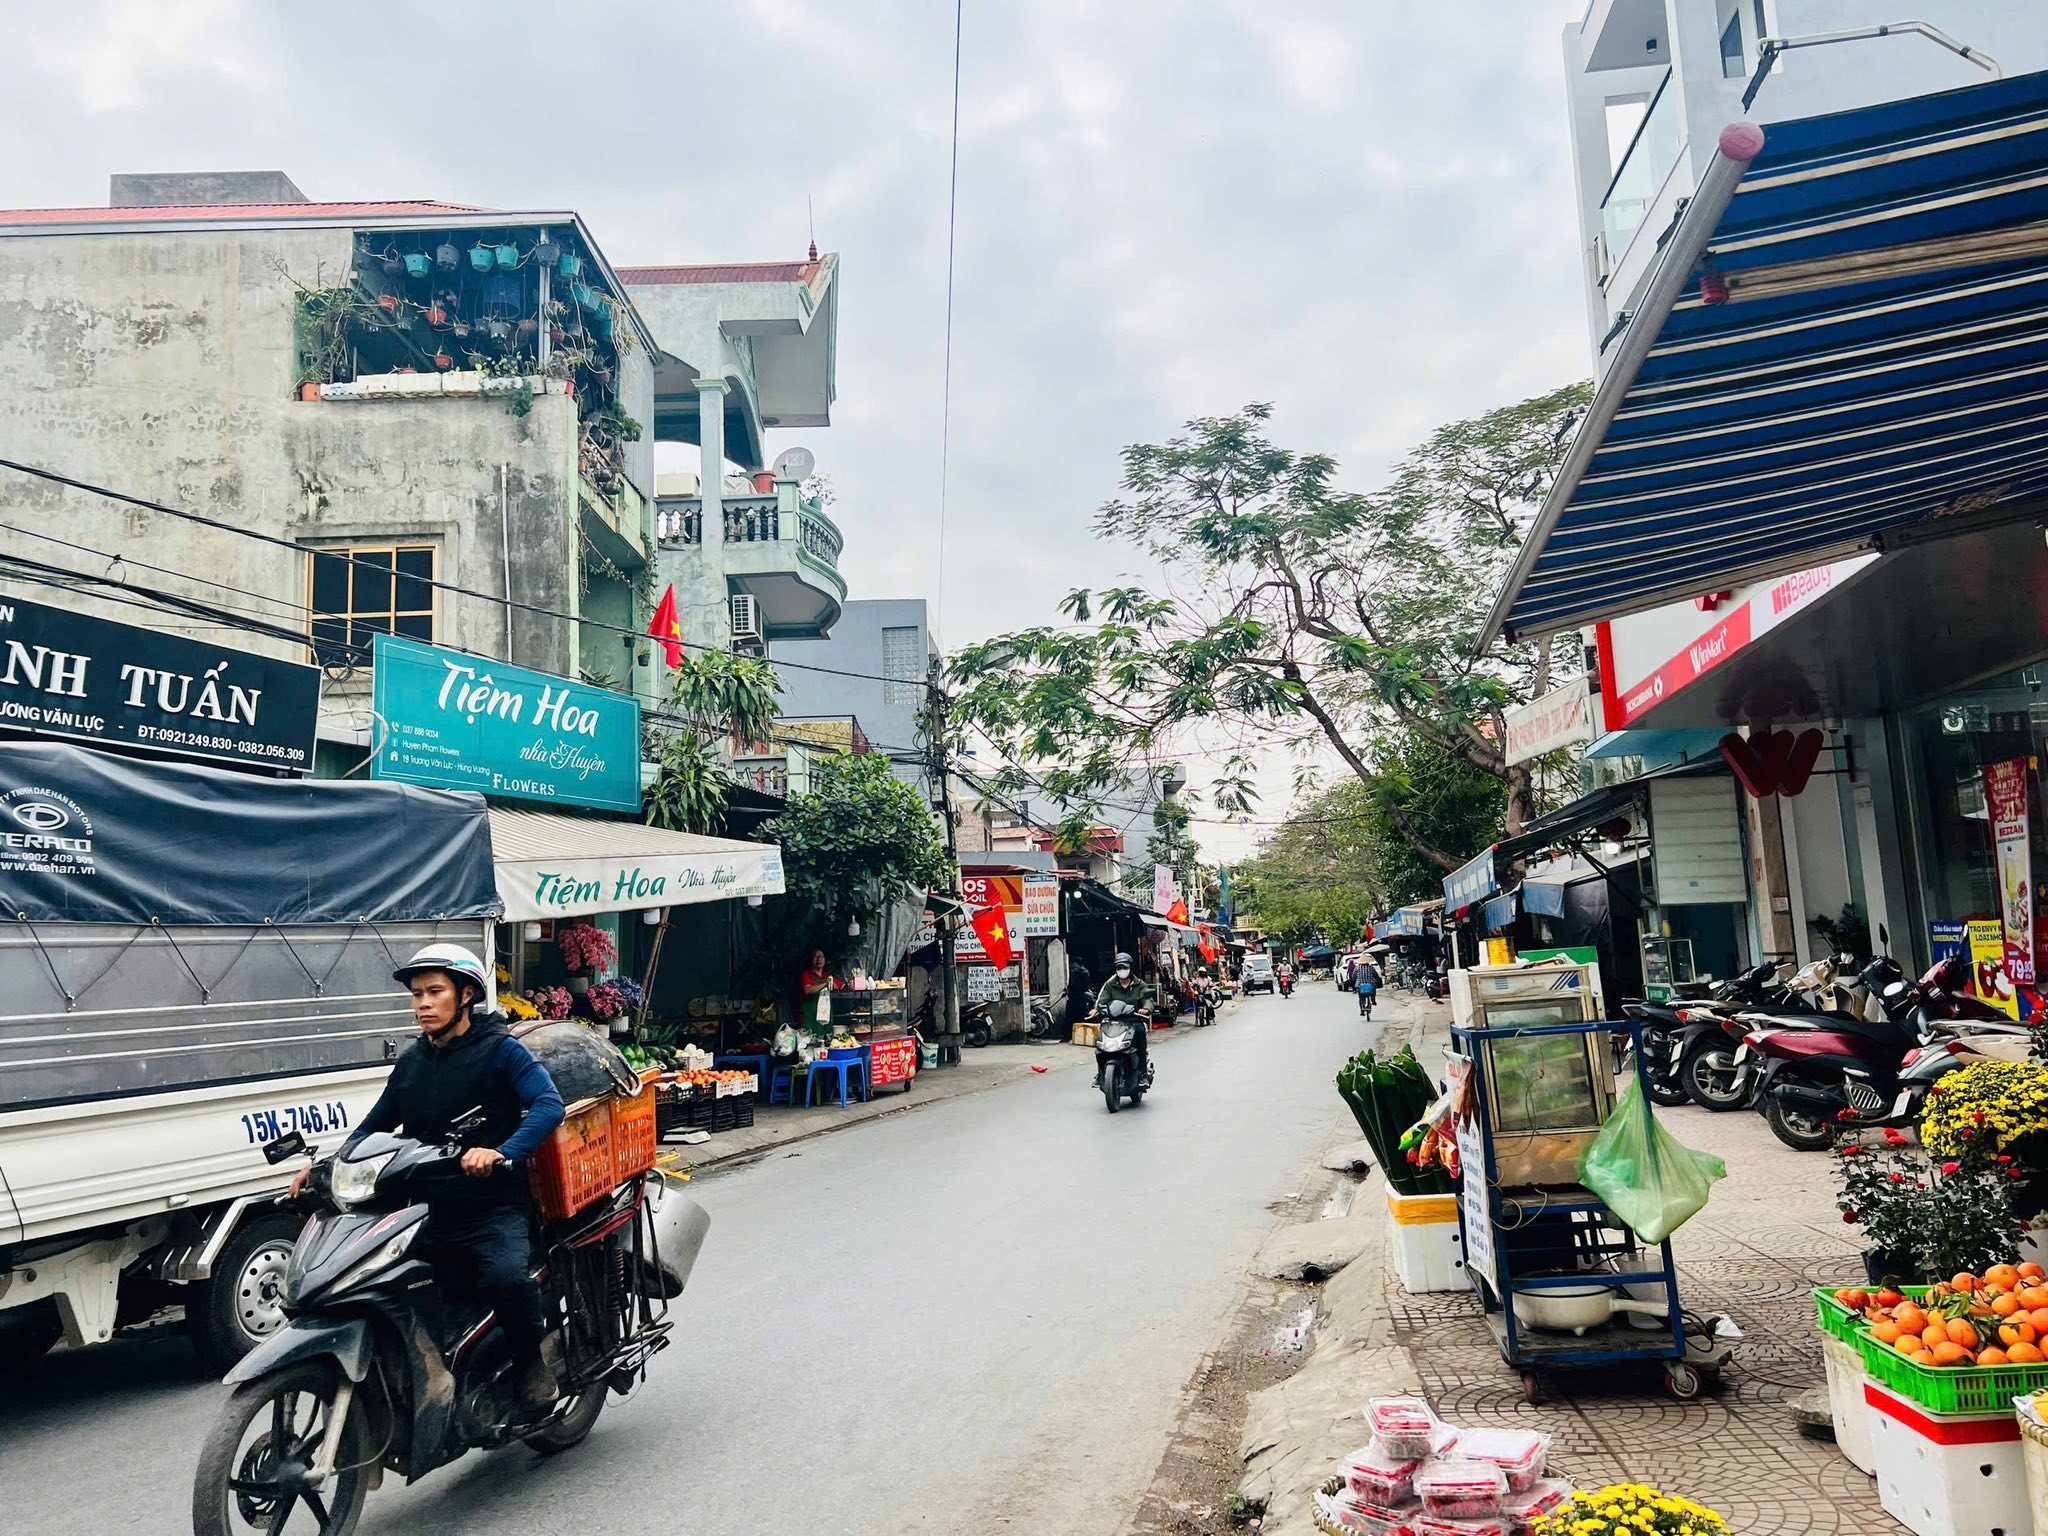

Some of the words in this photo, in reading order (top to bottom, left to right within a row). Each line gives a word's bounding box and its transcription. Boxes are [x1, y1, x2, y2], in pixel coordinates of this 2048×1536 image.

[120, 661, 262, 726] TUẤN
[438, 658, 523, 725] Tiệm
[532, 684, 600, 737] Hoa
[43, 708, 72, 726] VĂN
[75, 715, 105, 732] LỰC
[520, 738, 549, 763] nhà
[557, 742, 606, 781] Huyền
[10, 787, 33, 798] TNHH
[34, 787, 69, 804] DAEHAN
[67, 800, 94, 836] MOTORS
[52, 854, 73, 863] 409
[534, 871, 600, 911] Tiệm
[613, 867, 666, 901] Hoa
[241, 1101, 348, 1143] 15K-746.41
[407, 1279, 433, 1290] HONDA
